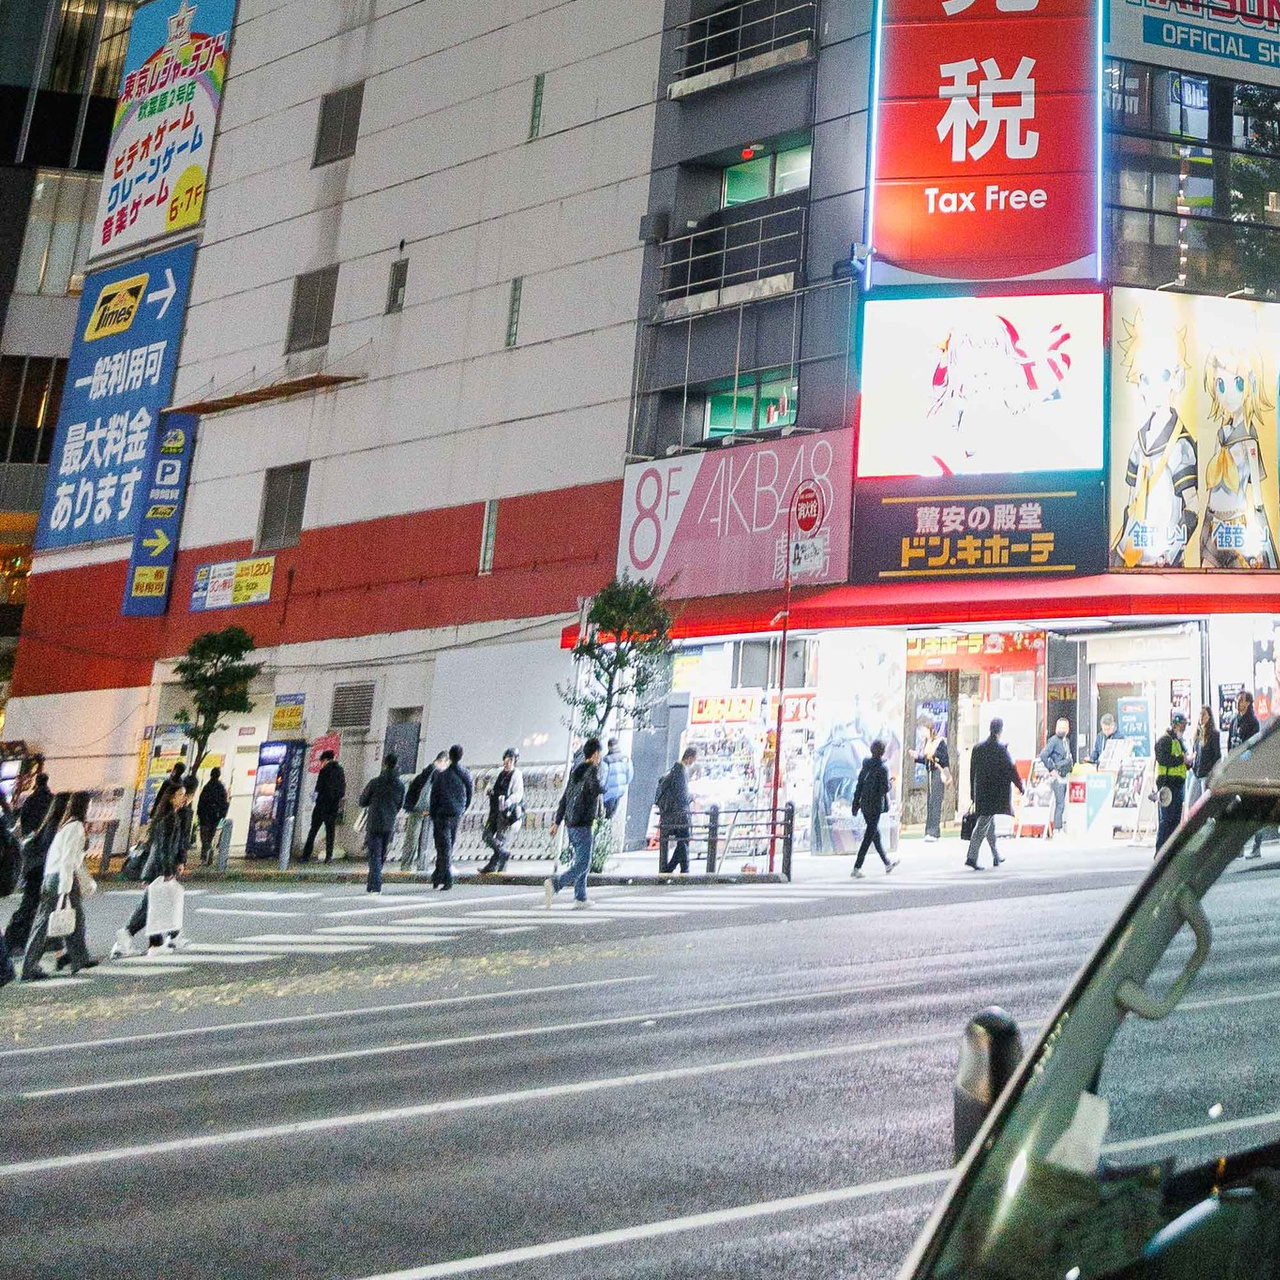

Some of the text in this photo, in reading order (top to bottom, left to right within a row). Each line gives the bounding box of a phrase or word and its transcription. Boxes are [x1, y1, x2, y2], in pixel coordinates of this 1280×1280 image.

[121, 31, 229, 102] 東京レジャーランド
[1161, 22, 1250, 58] OFFICIAL
[138, 81, 197, 122] 秋葉原2号店
[107, 124, 204, 213] クレーンゲーム
[113, 103, 196, 180] ビデオゲーム
[101, 177, 170, 246] 音楽ゲーム
[924, 184, 1049, 213] Tax Free
[95, 303, 134, 334] Times
[75, 340, 168, 400] 一般利用可
[59, 406, 153, 476] 最大料金
[50, 466, 143, 532] あります
[628, 465, 684, 571] 8F
[698, 440, 835, 538] AKB48
[916, 502, 1043, 534] 驚安の殿堂
